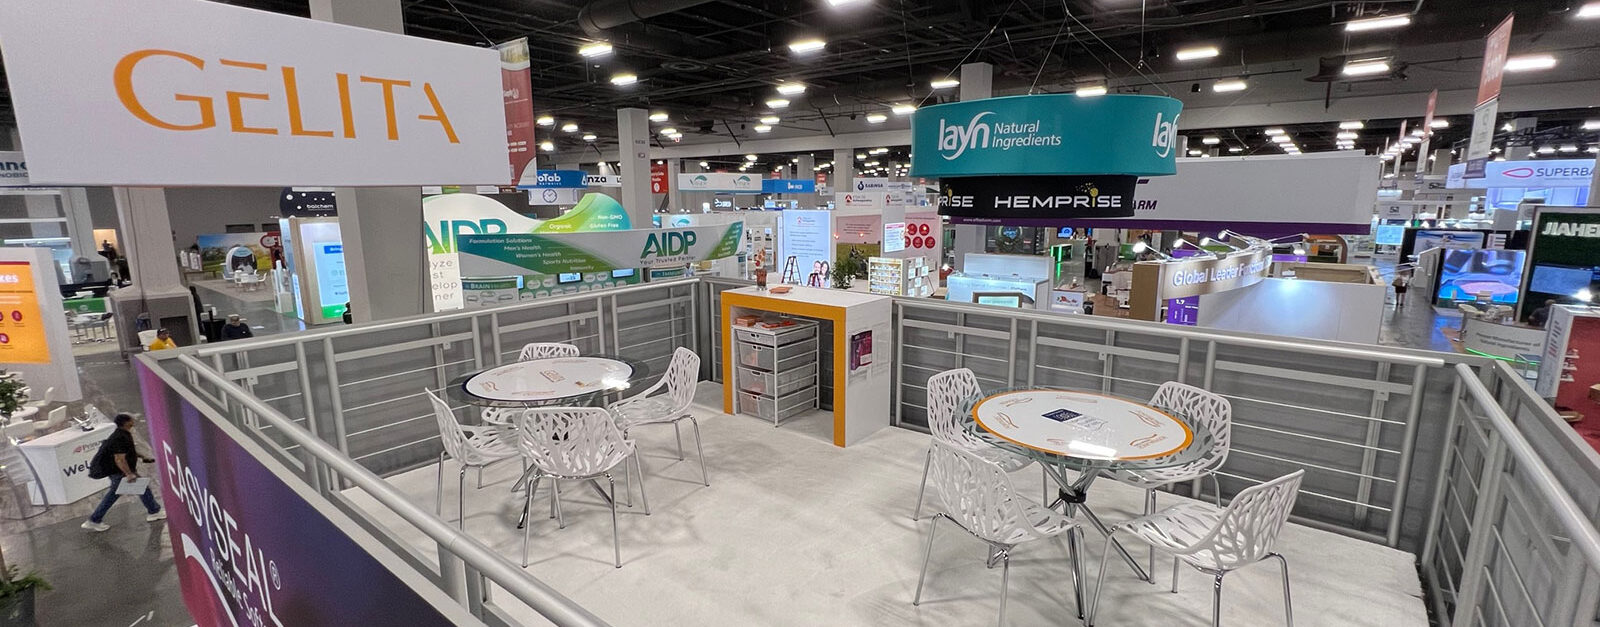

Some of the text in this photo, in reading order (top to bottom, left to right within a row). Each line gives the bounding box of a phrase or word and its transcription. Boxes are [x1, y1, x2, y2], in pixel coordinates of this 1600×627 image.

[113, 49, 461, 144] GELITA
[938, 111, 997, 161] layn
[994, 119, 1040, 134] Natural
[992, 134, 1062, 151] Ingredients
[994, 193, 1122, 209] HEMPRISE
[640, 230, 697, 259] AIDP
[1173, 268, 1208, 287] Global
[1210, 264, 1238, 282] Leader
